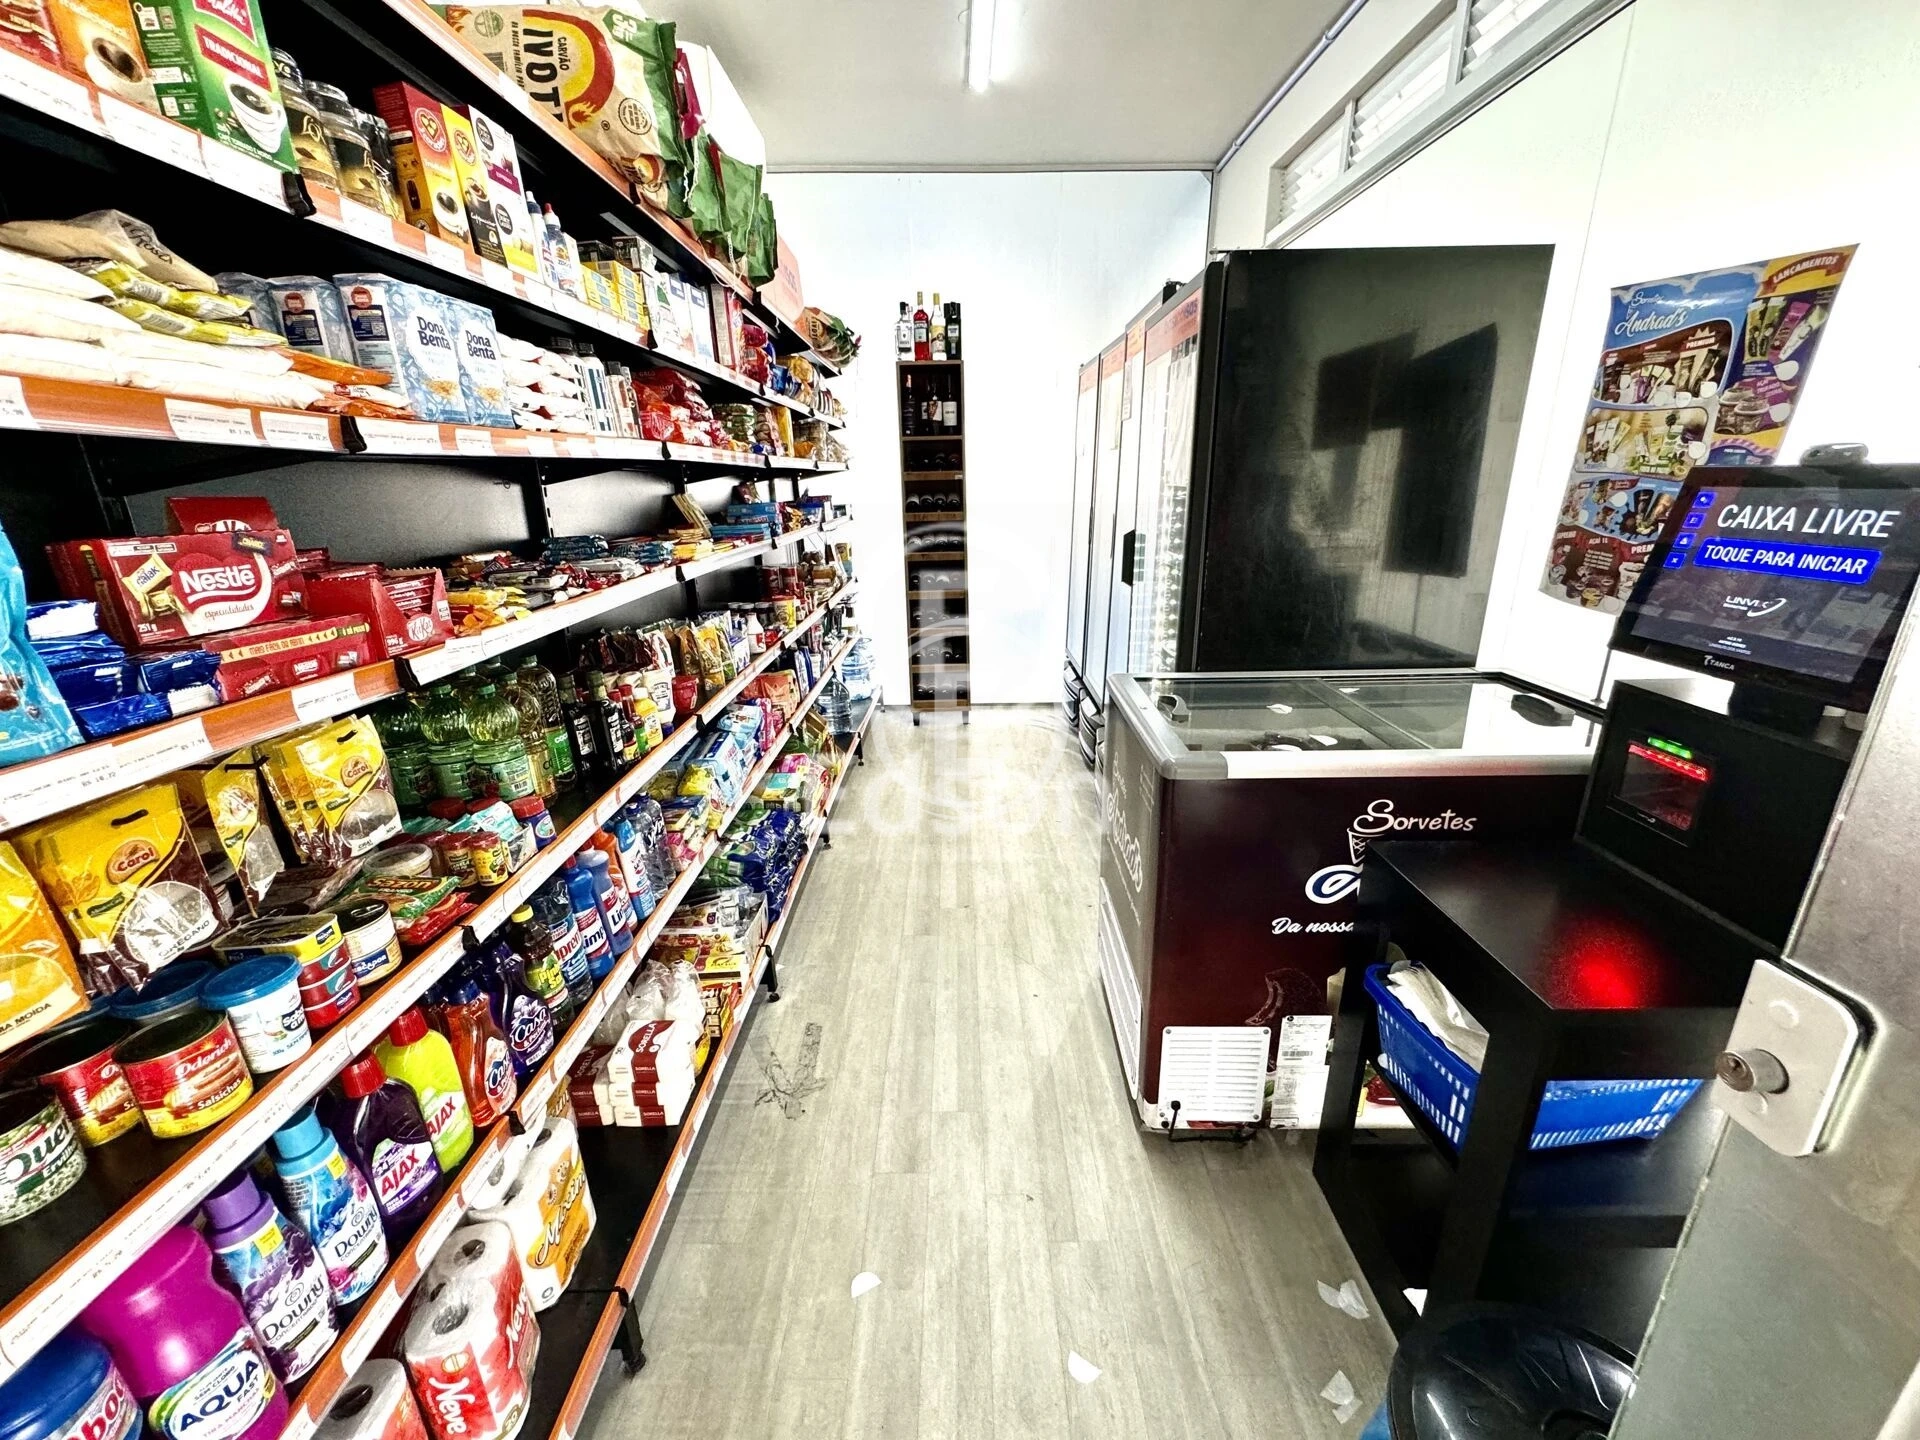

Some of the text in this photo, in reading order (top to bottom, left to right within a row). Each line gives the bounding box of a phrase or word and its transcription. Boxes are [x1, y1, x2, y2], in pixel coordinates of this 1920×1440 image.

[202, 34, 266, 81] TRADICIONAL
[1772, 254, 1840, 284] LANÇAMENTOS
[416, 315, 446, 338] Dona
[417, 330, 453, 352] Benta
[464, 328, 492, 348] Dona
[466, 343, 498, 361] Benta
[1685, 336, 1716, 350] PREMIUM
[1716, 503, 1901, 539] CAIXA LIVRE
[1703, 544, 1869, 575] TOQUE PARA INICIAR
[178, 563, 257, 595] Nestlé
[1352, 799, 1478, 834] Sorvetes
[1271, 916, 1302, 935] Da
[514, 1006, 547, 1044] Casa
[635, 1022, 657, 1054] SORELLA
[634, 1065, 657, 1073] SORELLA
[197, 1077, 242, 1111] Salsichas
[634, 1088, 657, 1096] SORELLA
[426, 1096, 456, 1136] AJAX
[577, 1110, 600, 1118] SORELLA
[643, 1109, 666, 1117] SORELLA
[380, 1150, 420, 1198] AJAX
[333, 1207, 378, 1258] Downy
[261, 1275, 325, 1341] Downy
[179, 1358, 260, 1433] AQUA
[236, 1374, 260, 1404] FAST
[428, 1376, 477, 1435] Neve
